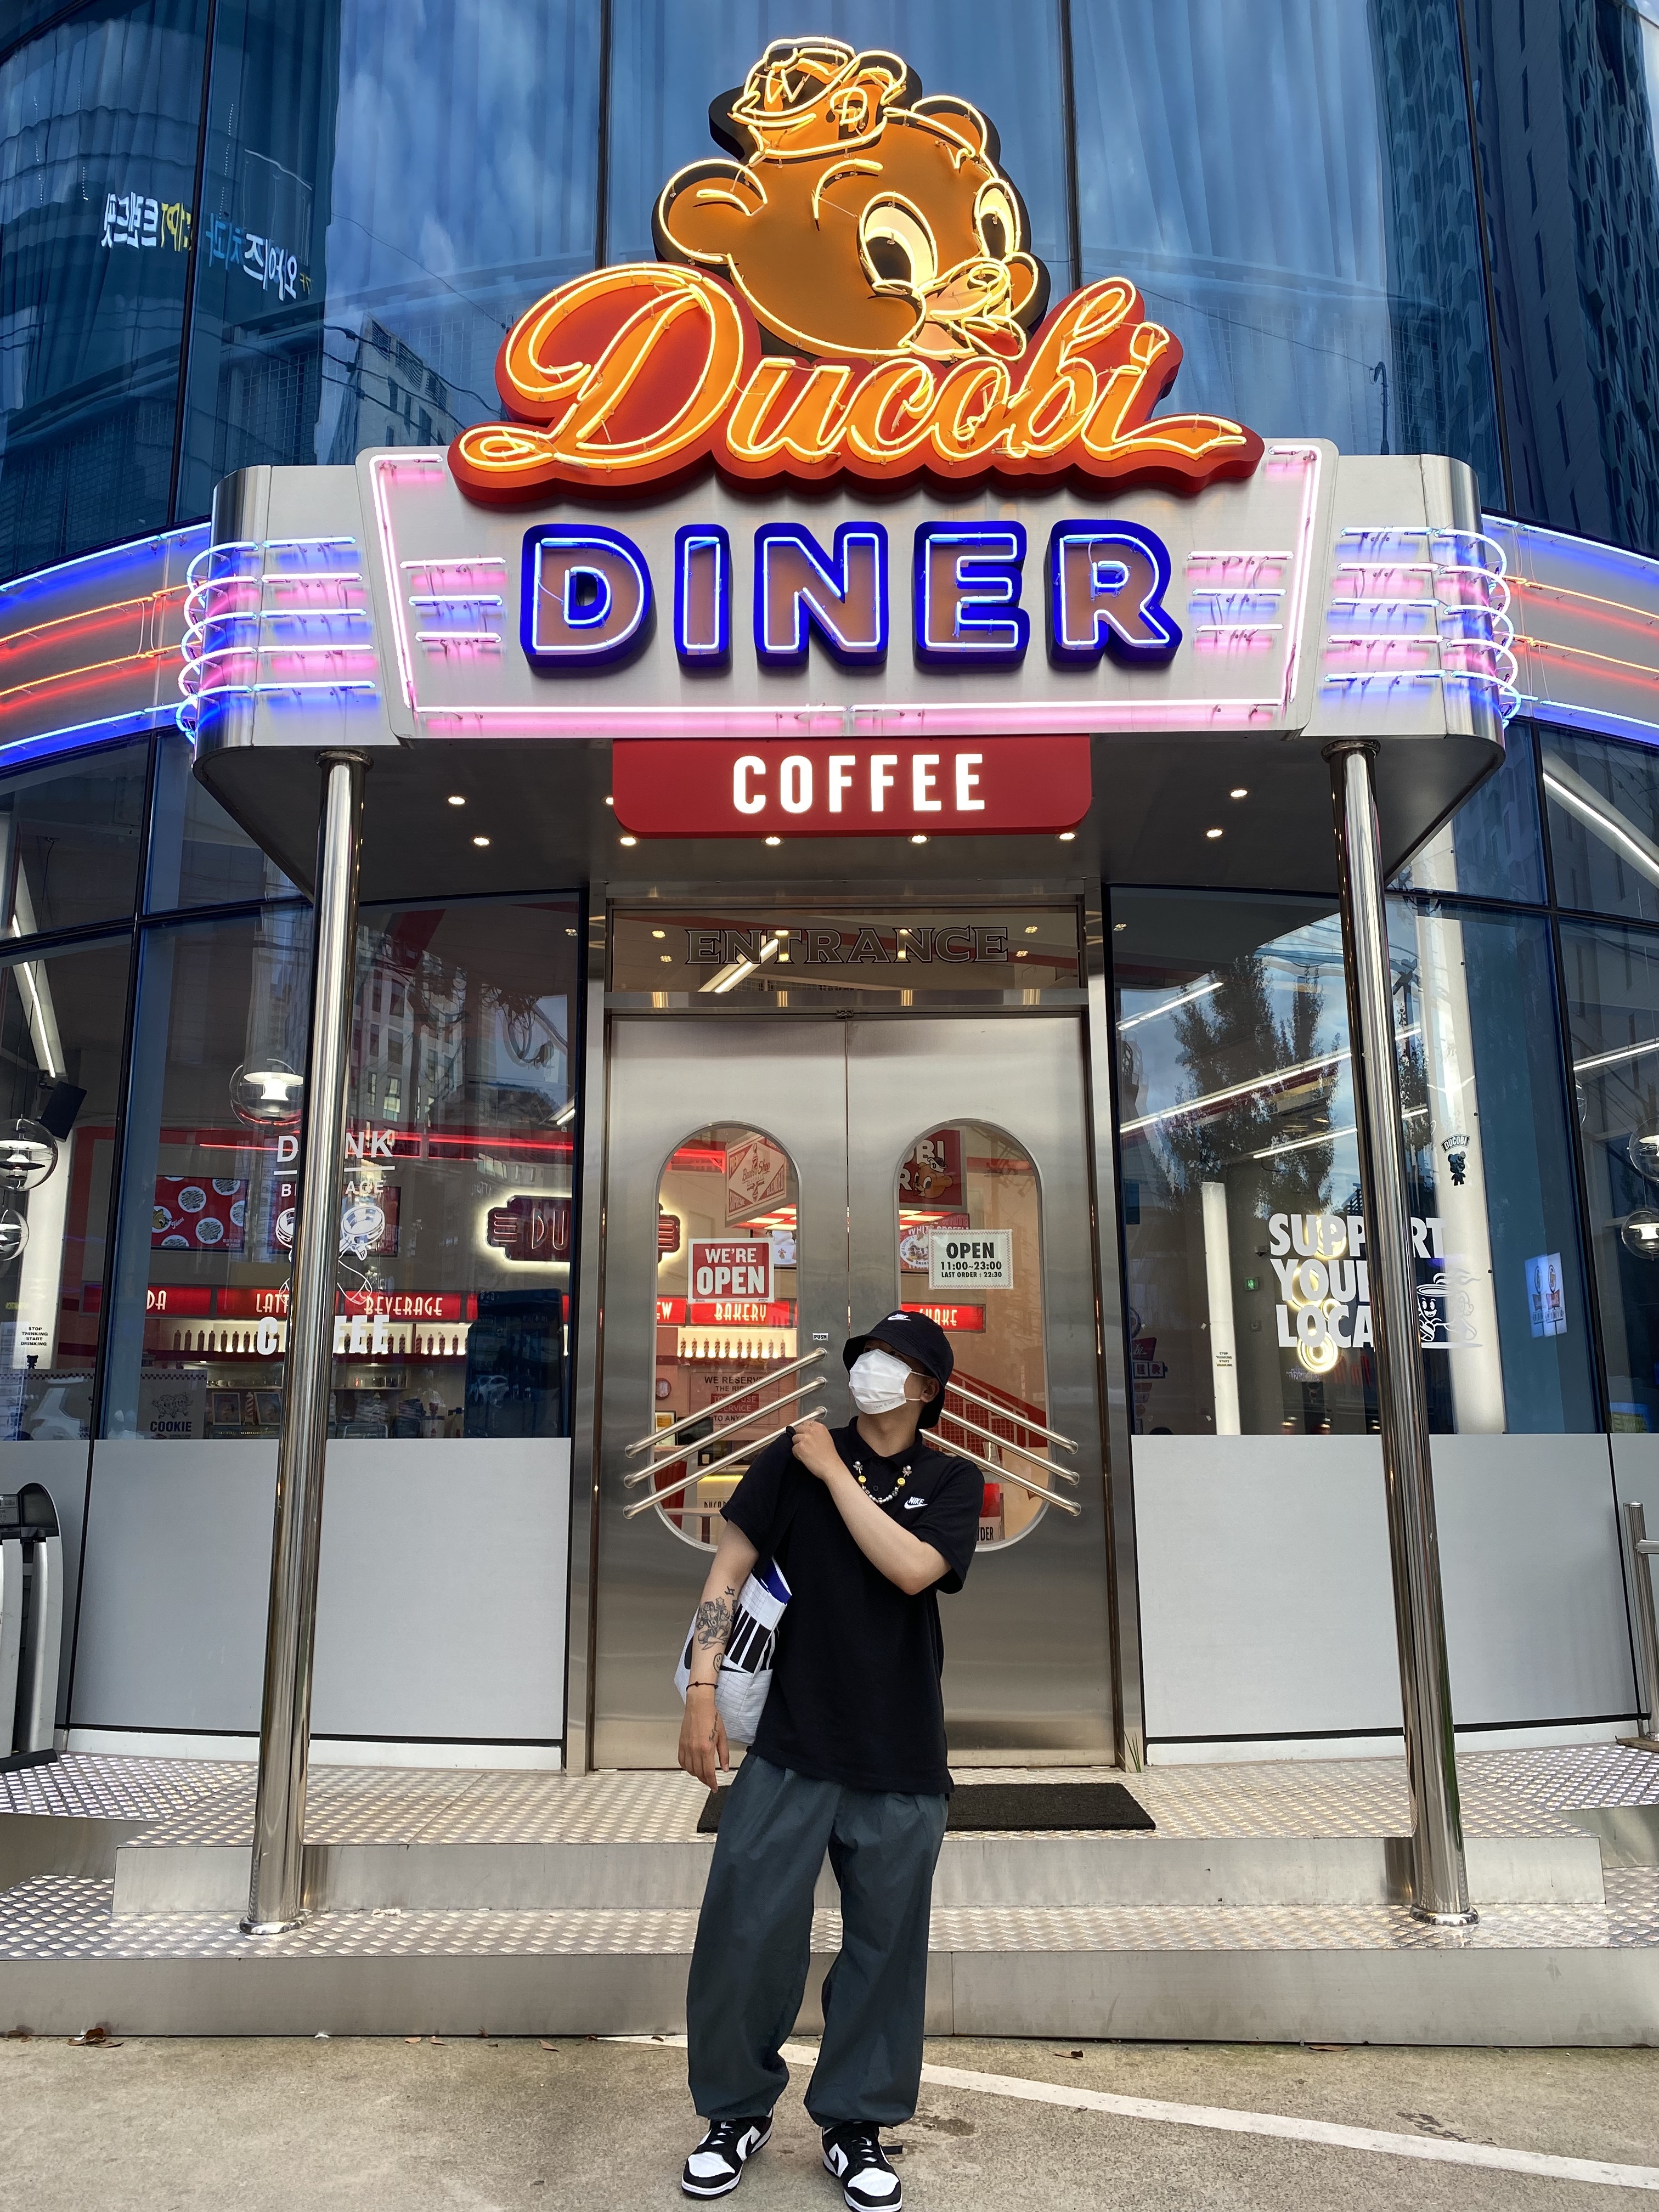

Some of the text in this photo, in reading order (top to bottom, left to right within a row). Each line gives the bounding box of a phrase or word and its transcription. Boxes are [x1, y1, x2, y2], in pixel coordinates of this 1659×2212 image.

[456, 262, 1250, 474] Ducobi
[520, 518, 1183, 678] DINER
[733, 753, 986, 814] COFFEE
[684, 924, 1009, 965] ENTRANCE
[1443, 1135, 1468, 1150] DUCOBI
[758, 1159, 771, 1175] Shop
[908, 1225, 930, 1235] WHIT
[1268, 1213, 1445, 1259] SUPPRT
[704, 1248, 757, 1263] WE'RE
[946, 1242, 995, 1259] OPEN
[940, 1261, 1002, 1271] 11:00~23:00
[696, 1266, 765, 1296] OPEN
[1270, 1259, 1370, 1302] YOU
[256, 1293, 289, 1313] LATT
[363, 1296, 443, 1317] BEVERAGE
[714, 1302, 766, 1322] BAKERY
[1276, 1304, 1374, 1348] LOCA
[704, 1376, 763, 1384] WE RESERV
[150, 1421, 192, 1432] COOKIE
[908, 1496, 926, 1505] NIKE
